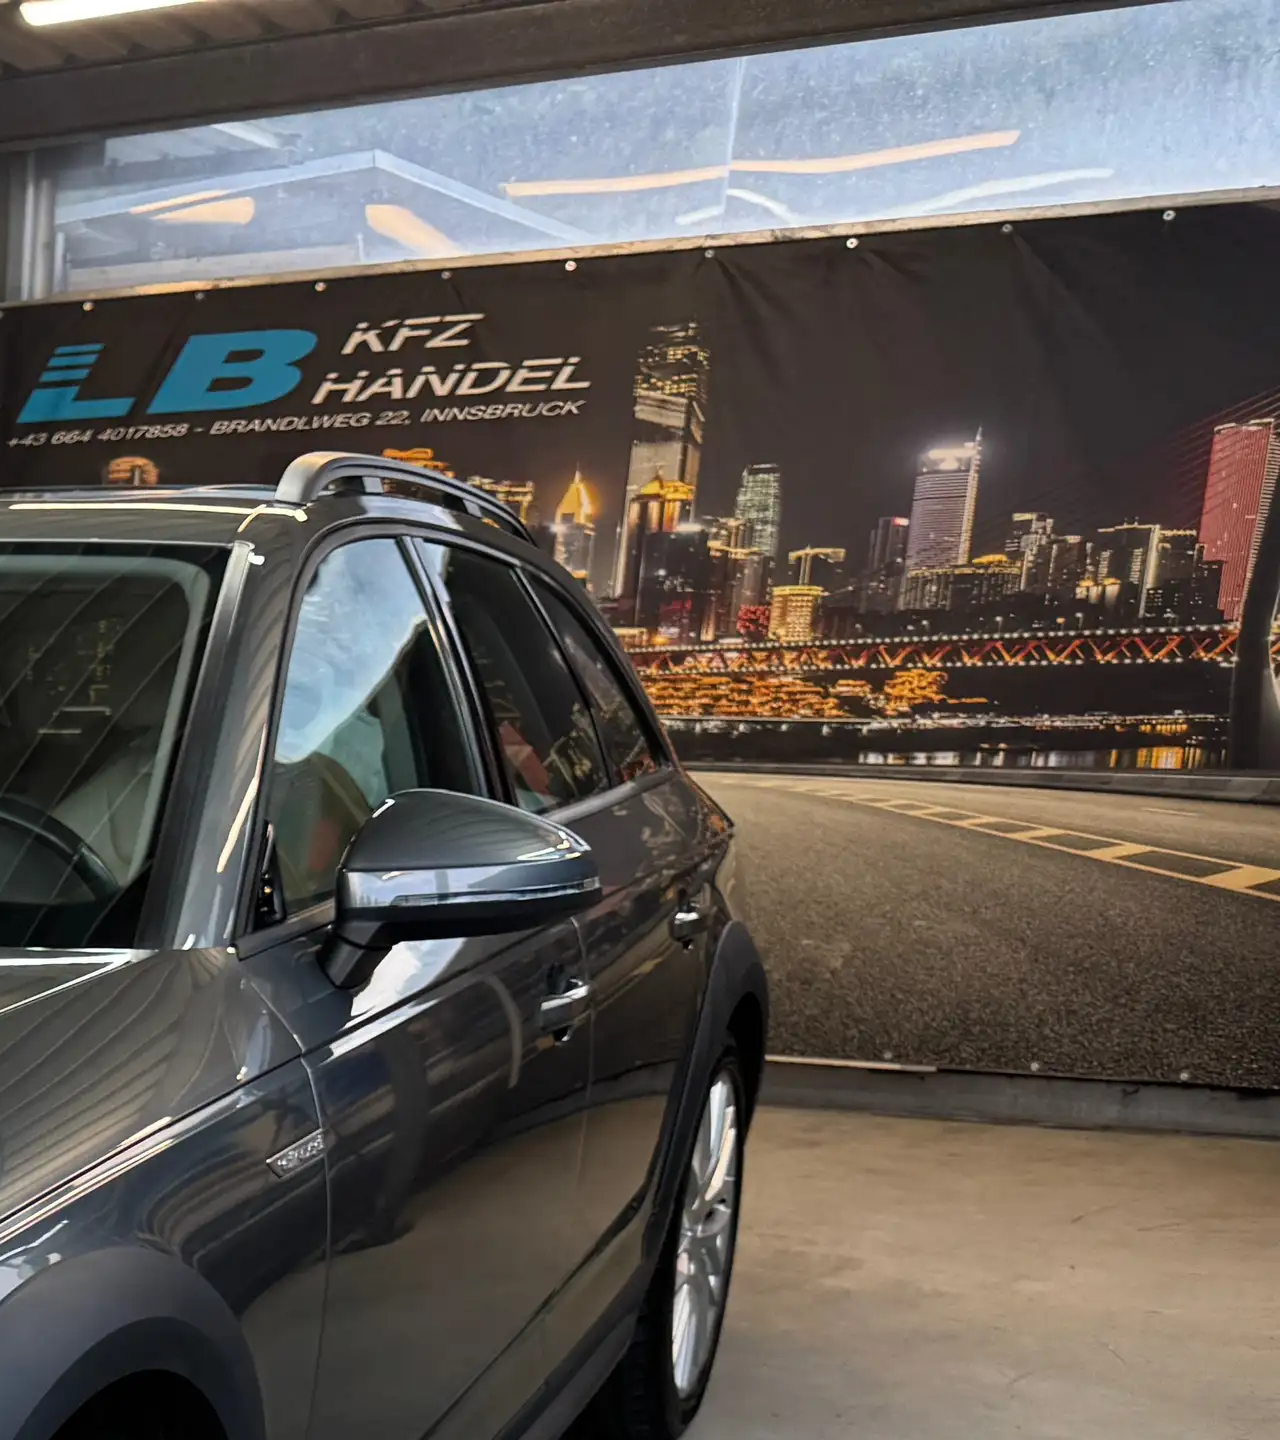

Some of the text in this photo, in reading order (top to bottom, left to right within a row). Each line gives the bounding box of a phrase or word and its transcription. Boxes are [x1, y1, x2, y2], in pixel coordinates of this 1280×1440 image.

[341, 313, 486, 355] KFZ
[311, 357, 593, 405] HANDEL
[6, 432, 49, 448] +43
[51, 429, 94, 445] 664
[97, 423, 189, 441] 4017858
[209, 413, 371, 436] BRANDLWEG
[419, 399, 588, 424] INNSBRUCK
